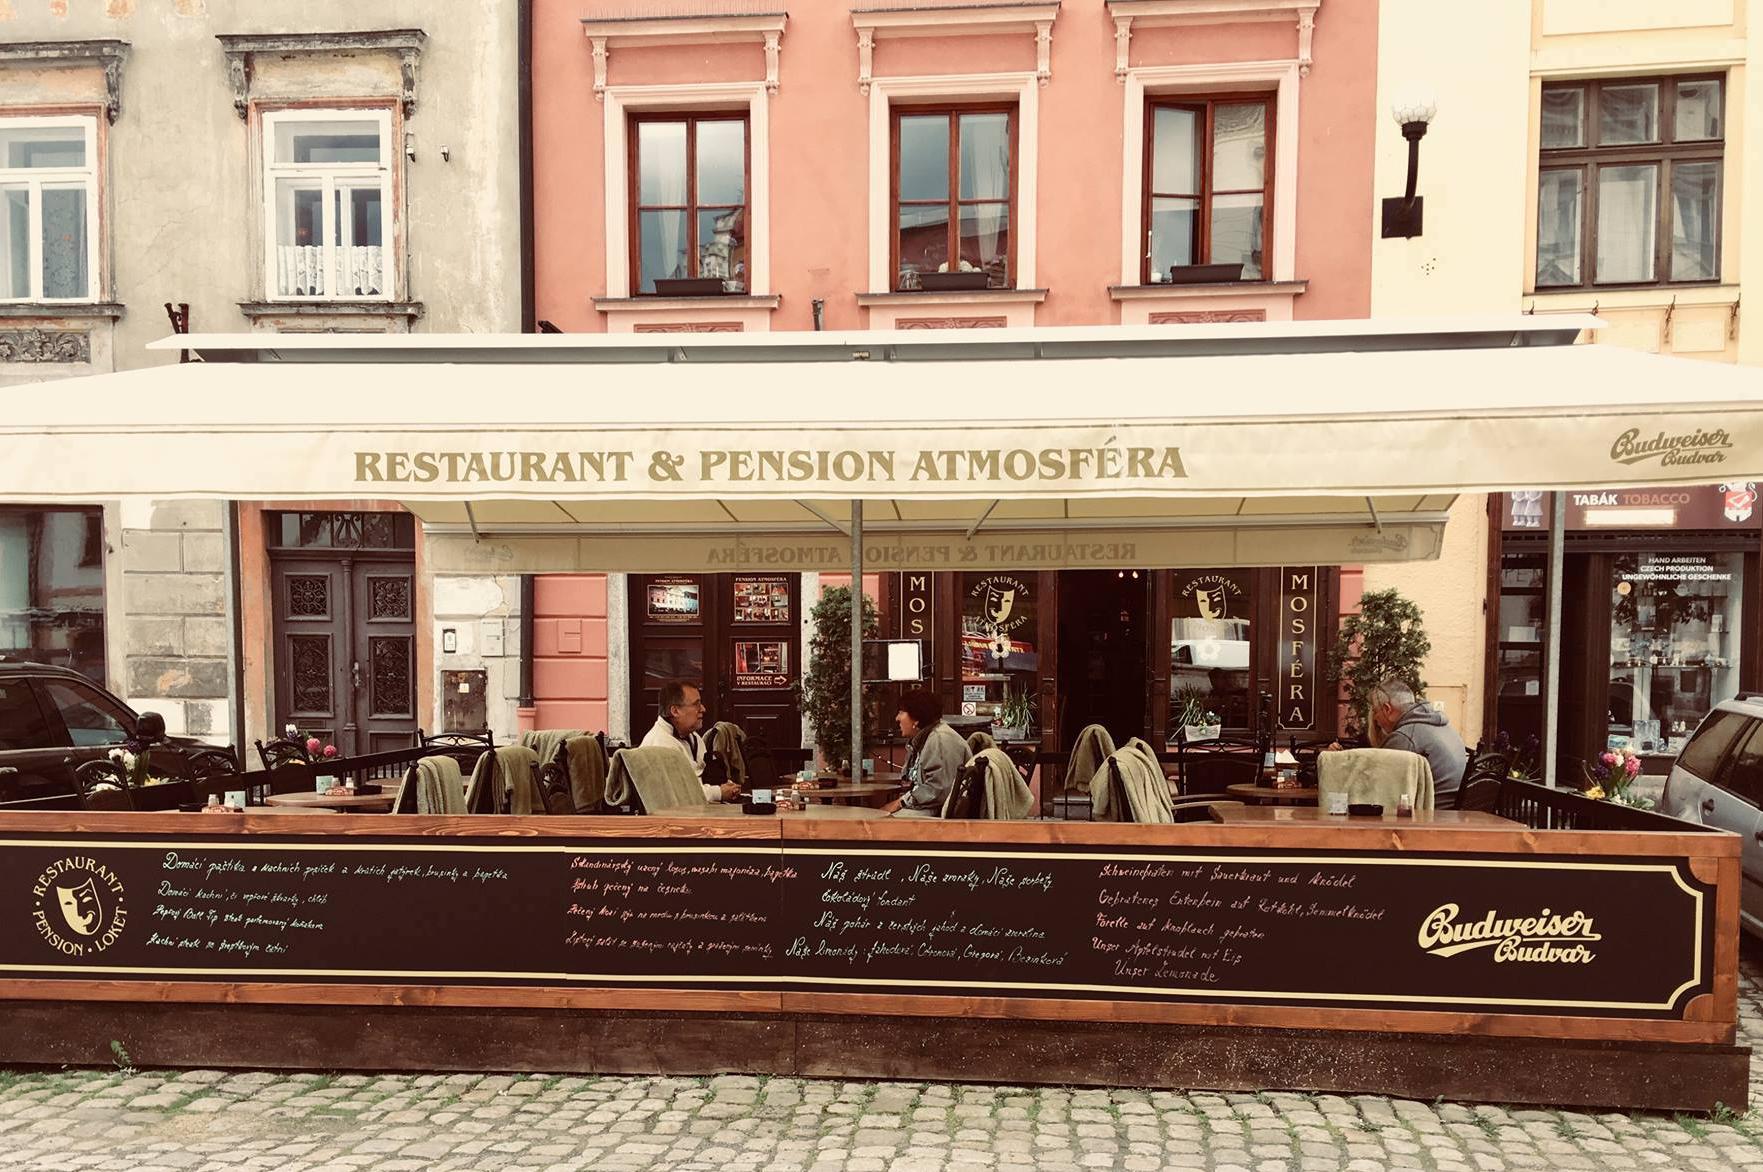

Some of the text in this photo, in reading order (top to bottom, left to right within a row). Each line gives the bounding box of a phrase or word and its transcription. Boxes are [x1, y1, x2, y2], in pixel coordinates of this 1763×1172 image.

[1610, 428, 1734, 460] Budweiser
[353, 435, 1189, 482] RESTAURANT & PENSION ATMOSFÉRA
[1661, 448, 1727, 467] Budvar
[1573, 491, 1690, 506] TABÁK TOBACCO
[970, 576, 1030, 598] RESTAURANT
[1181, 575, 1242, 598] RESTAURANT
[163, 851, 207, 871] Domácí
[32, 856, 124, 898] RESTAURANT
[821, 861, 848, 883] Náš
[986, 866, 1015, 889] Naše
[1181, 865, 1204, 879] mit
[1277, 872, 1300, 885] und
[32, 906, 128, 956] PENSION LOKET
[813, 910, 839, 931] Náš
[1096, 911, 1129, 928] Forelle
[1136, 917, 1157, 931] auf
[1417, 902, 1602, 949] Budweiser
[785, 936, 811, 960] Naše
[1091, 936, 1120, 953] Unser
[1493, 935, 1597, 964] Budvar
[1114, 959, 1149, 980] Unser
